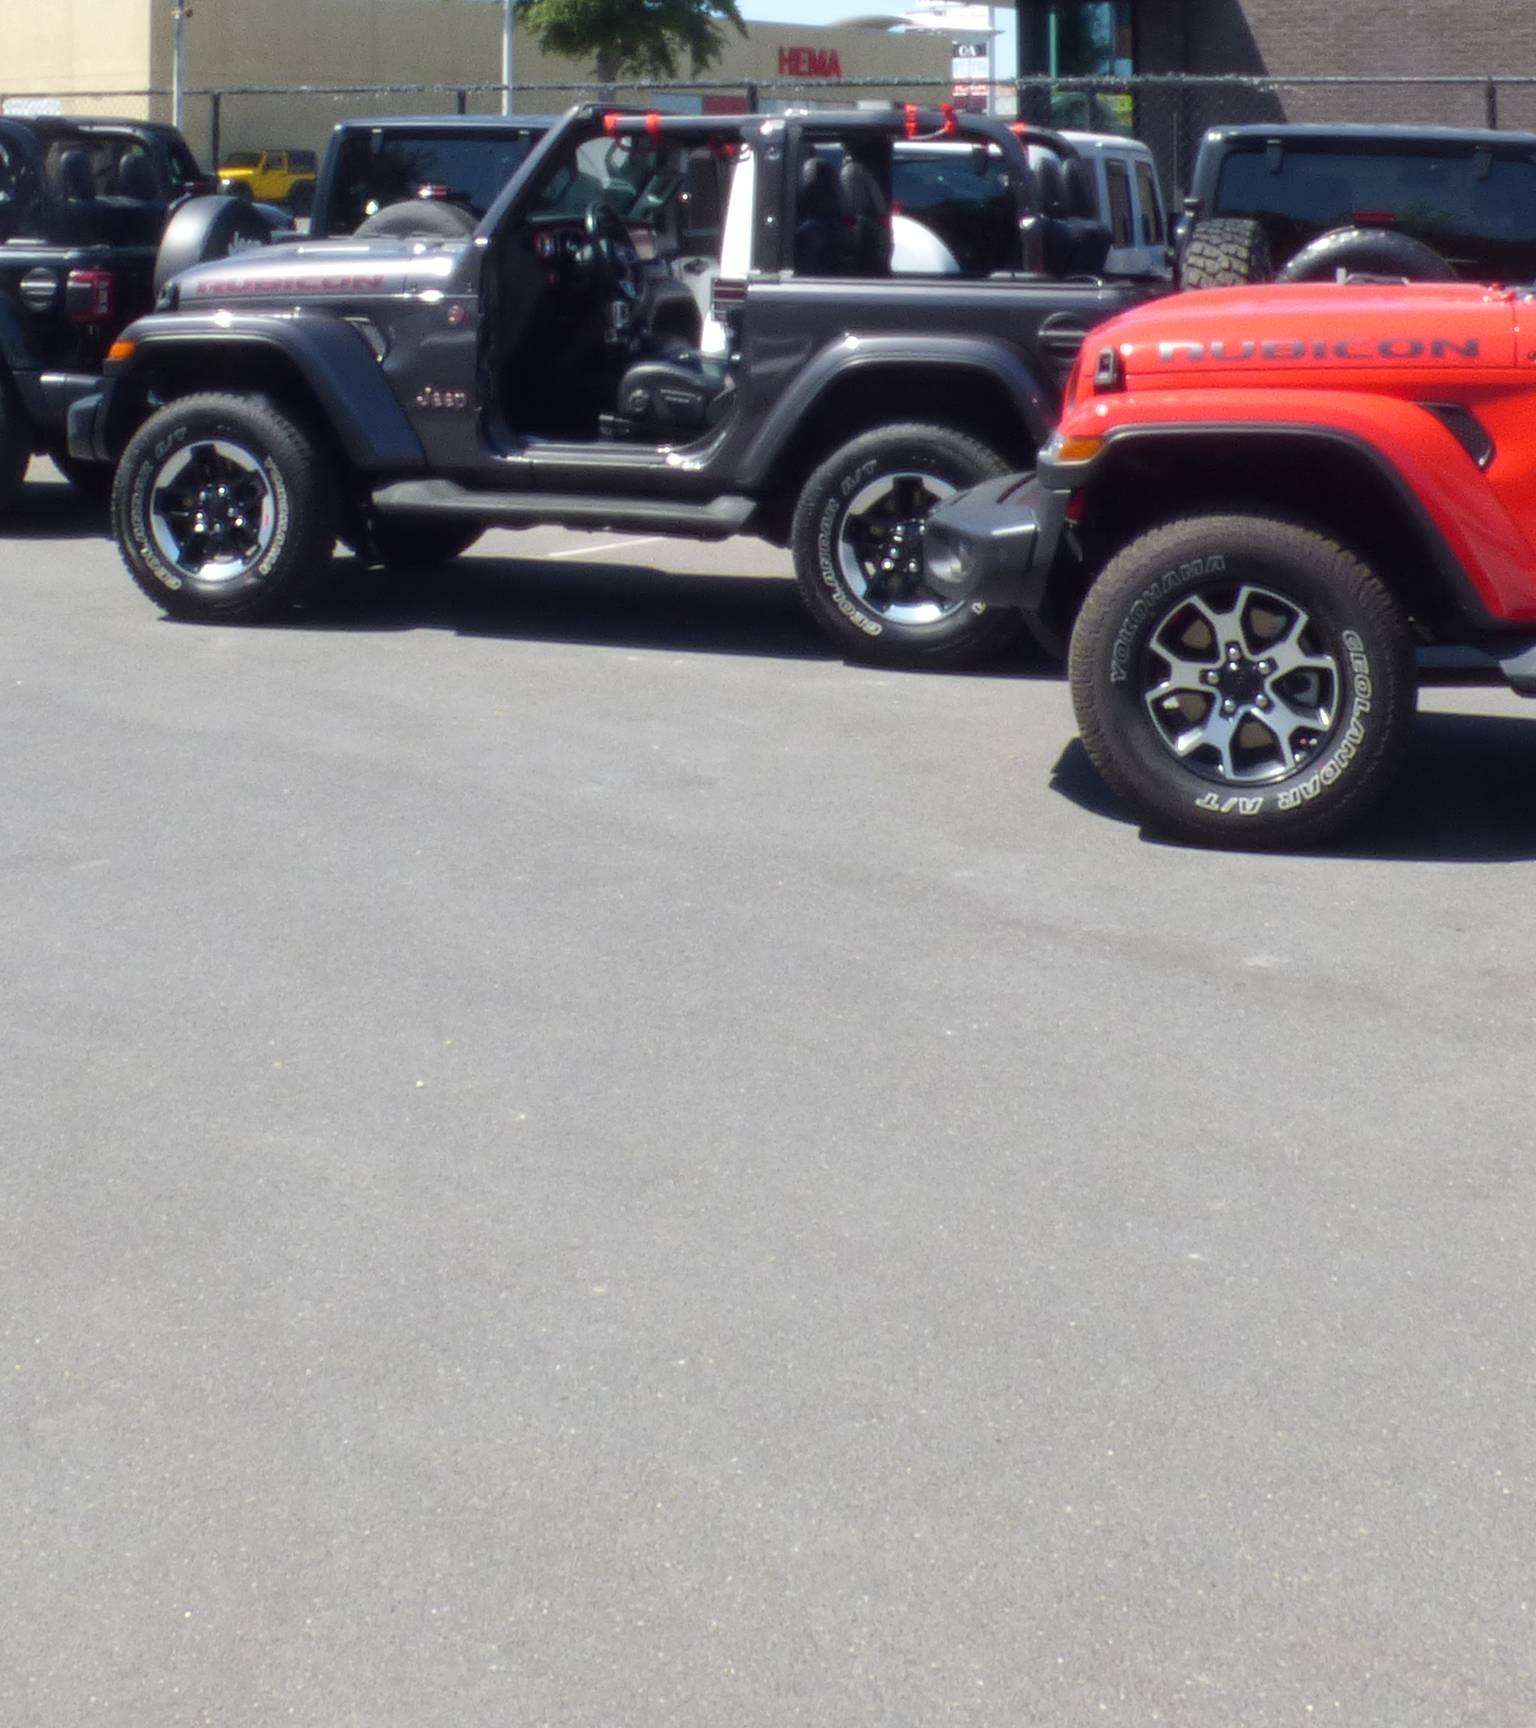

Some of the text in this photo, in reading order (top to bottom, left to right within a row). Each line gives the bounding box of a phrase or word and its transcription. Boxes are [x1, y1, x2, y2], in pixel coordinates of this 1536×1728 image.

[778, 46, 842, 77] HEMA
[1157, 338, 1480, 363] RUBICON
[1110, 554, 1226, 683] YOKOHAMA
[1195, 629, 1373, 815] GEOLANDAR A/T
